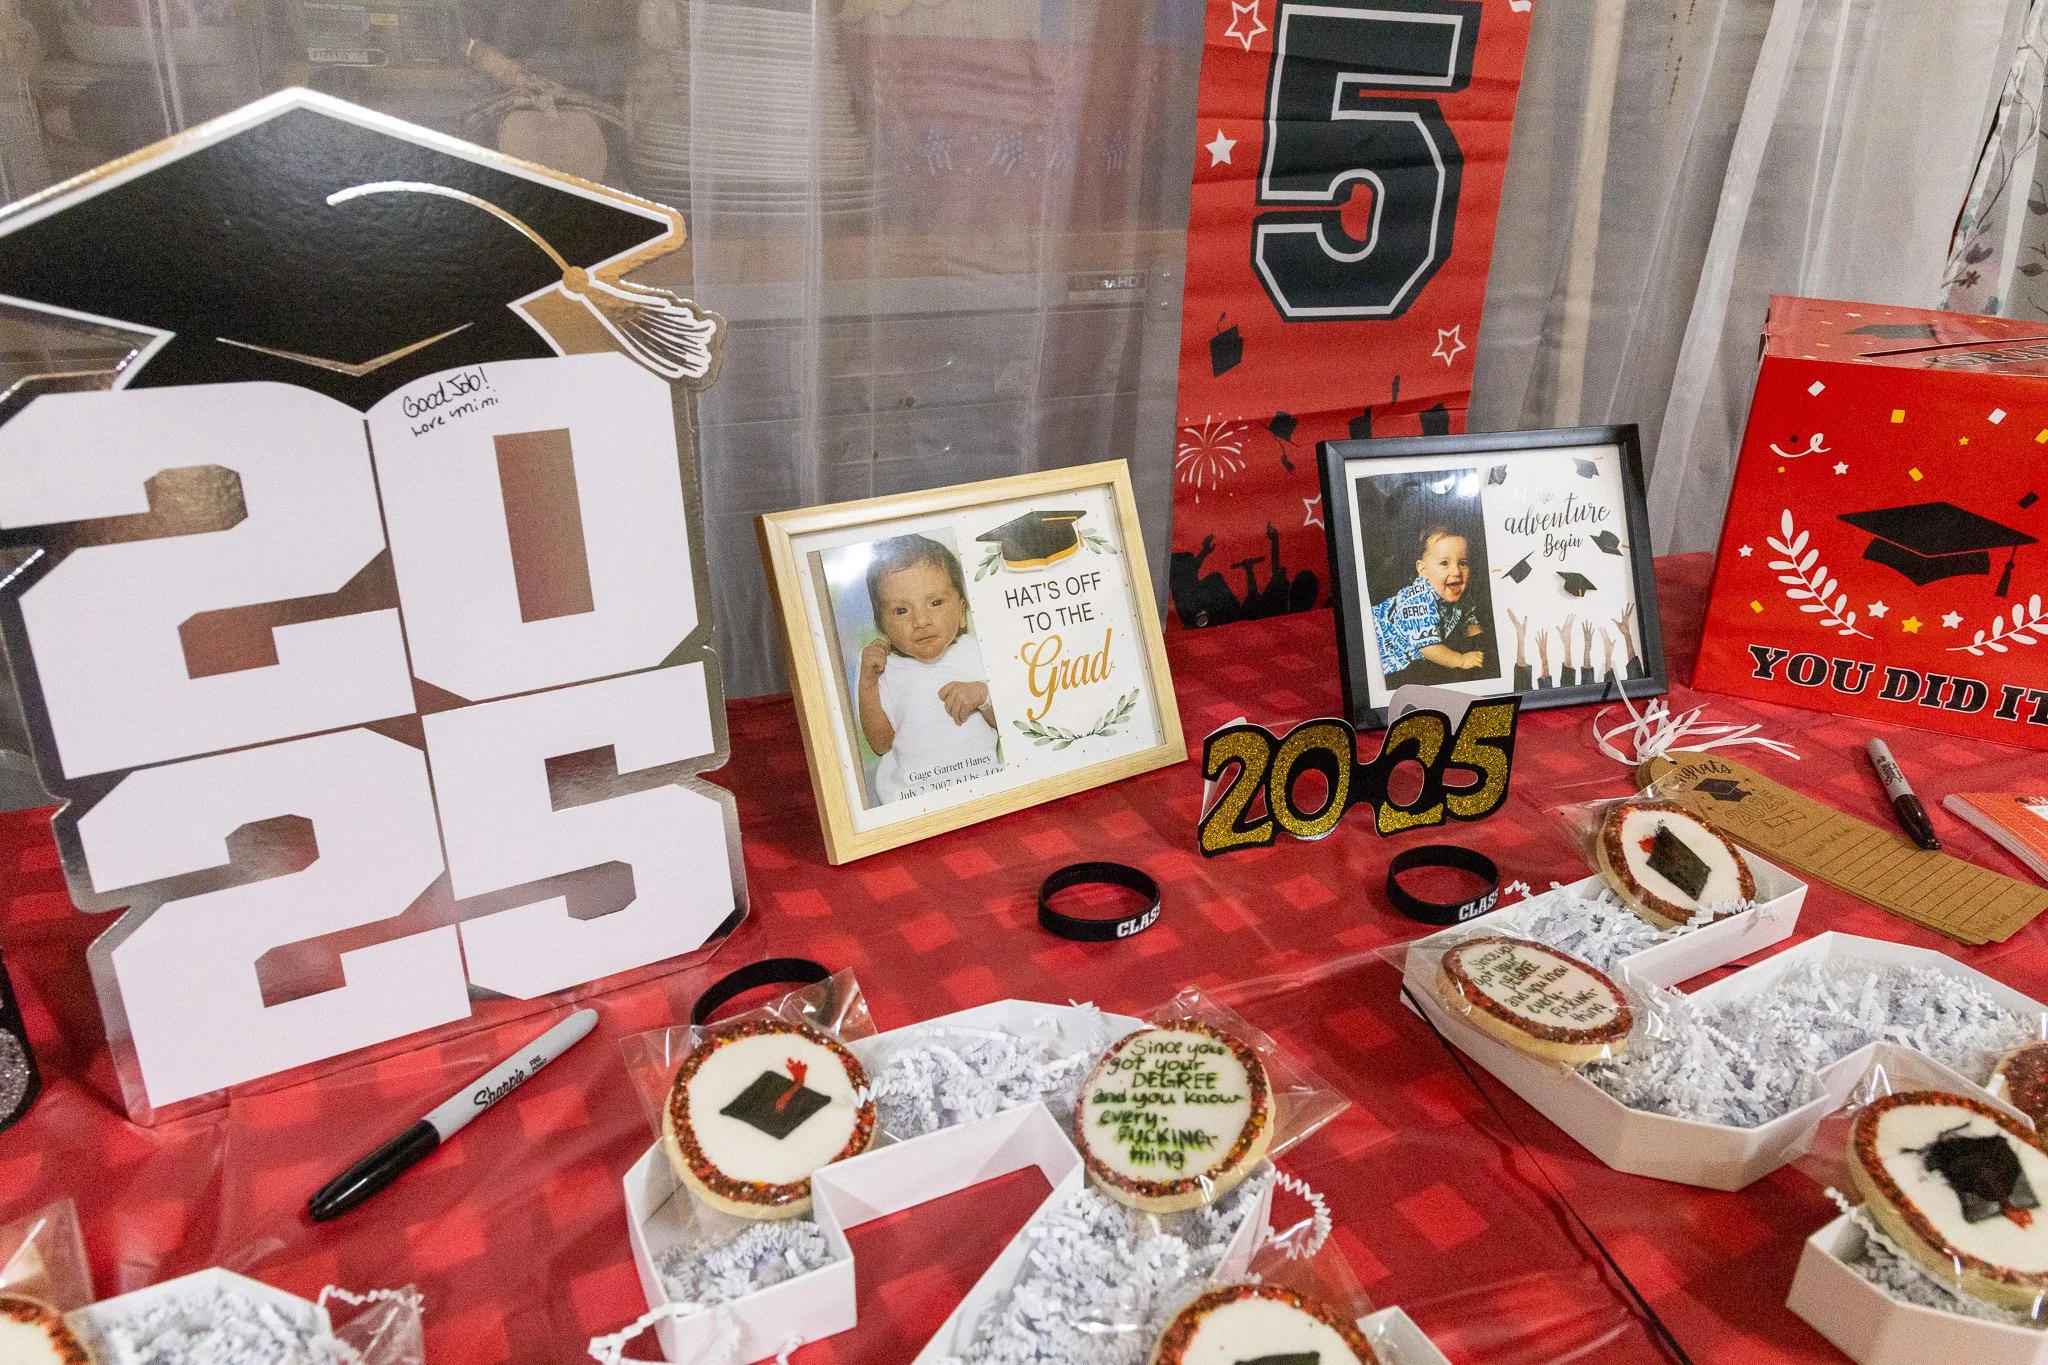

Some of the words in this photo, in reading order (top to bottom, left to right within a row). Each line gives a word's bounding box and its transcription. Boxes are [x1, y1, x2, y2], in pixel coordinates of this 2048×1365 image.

[1250, 0, 1480, 322] 5
[403, 381, 453, 418] Good
[1504, 492, 1611, 536] adventure
[1543, 533, 1584, 561] Begin
[0, 351, 699, 780] 20
[1004, 580, 1061, 609] HAT'S
[1065, 571, 1102, 596] OFF
[1023, 611, 1052, 633] TO
[1055, 602, 1095, 626] THE
[1020, 627, 1114, 721] Grad
[1748, 644, 1876, 695] YOU
[1878, 665, 1989, 713] DID
[909, 771, 932, 782] Gage
[934, 761, 963, 775] Garrett
[965, 755, 991, 768] Haney
[1725, 789, 1788, 827] 2025
[77, 661, 736, 1108] 25
[1468, 950, 1499, 970] Since
[1500, 959, 1541, 990] DEGREE
[1473, 969, 1496, 988] got
[1131, 1039, 1182, 1056] Since
[1187, 1043, 1226, 1060] you
[1107, 1055, 1146, 1076] got
[1155, 1059, 1205, 1076] your
[1131, 1071, 1218, 1089] DEGREE
[473, 1068, 525, 1110] Sharpie
[1092, 1088, 1127, 1104] and
[1131, 1092, 1176, 1109] you
[1129, 1145, 1186, 1170] thing
